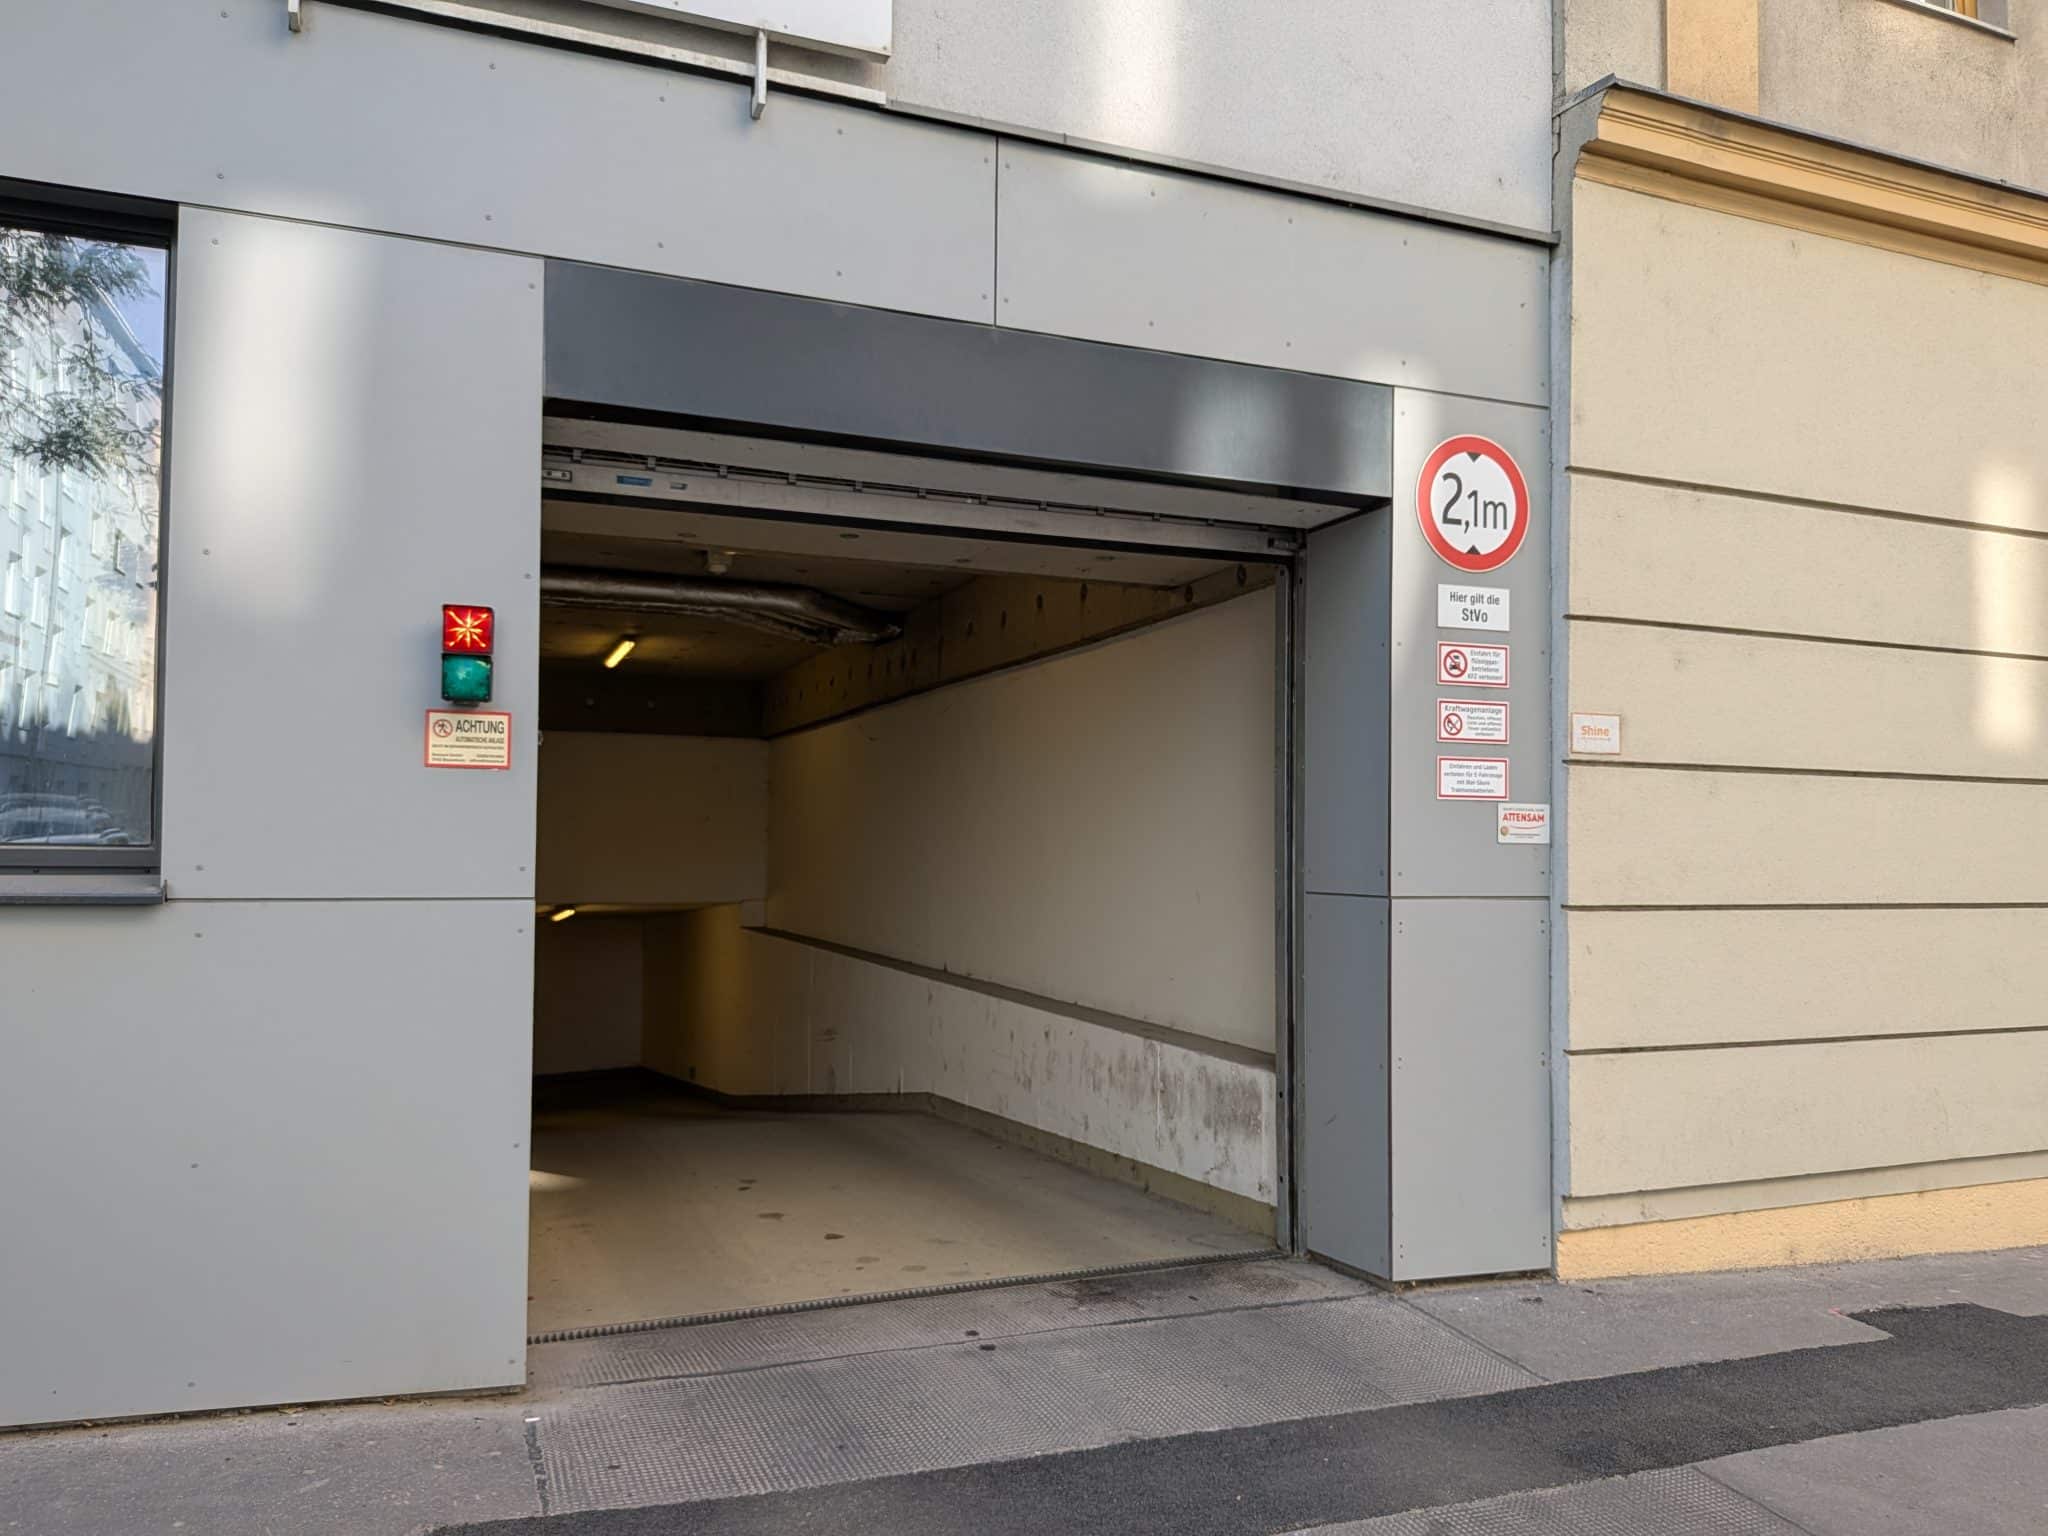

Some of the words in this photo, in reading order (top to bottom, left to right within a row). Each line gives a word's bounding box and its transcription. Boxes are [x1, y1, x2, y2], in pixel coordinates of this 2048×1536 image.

[1442, 472, 1508, 534] 2,1m
[1449, 592, 1467, 602] Hier
[1470, 593, 1484, 605] gilt
[1487, 595, 1500, 605] die
[1462, 608, 1488, 622] StVo
[1444, 705, 1502, 715] Kraftwagenanlage
[456, 720, 504, 734] ACHTUNG
[1503, 813, 1544, 822] ATTENSAM
